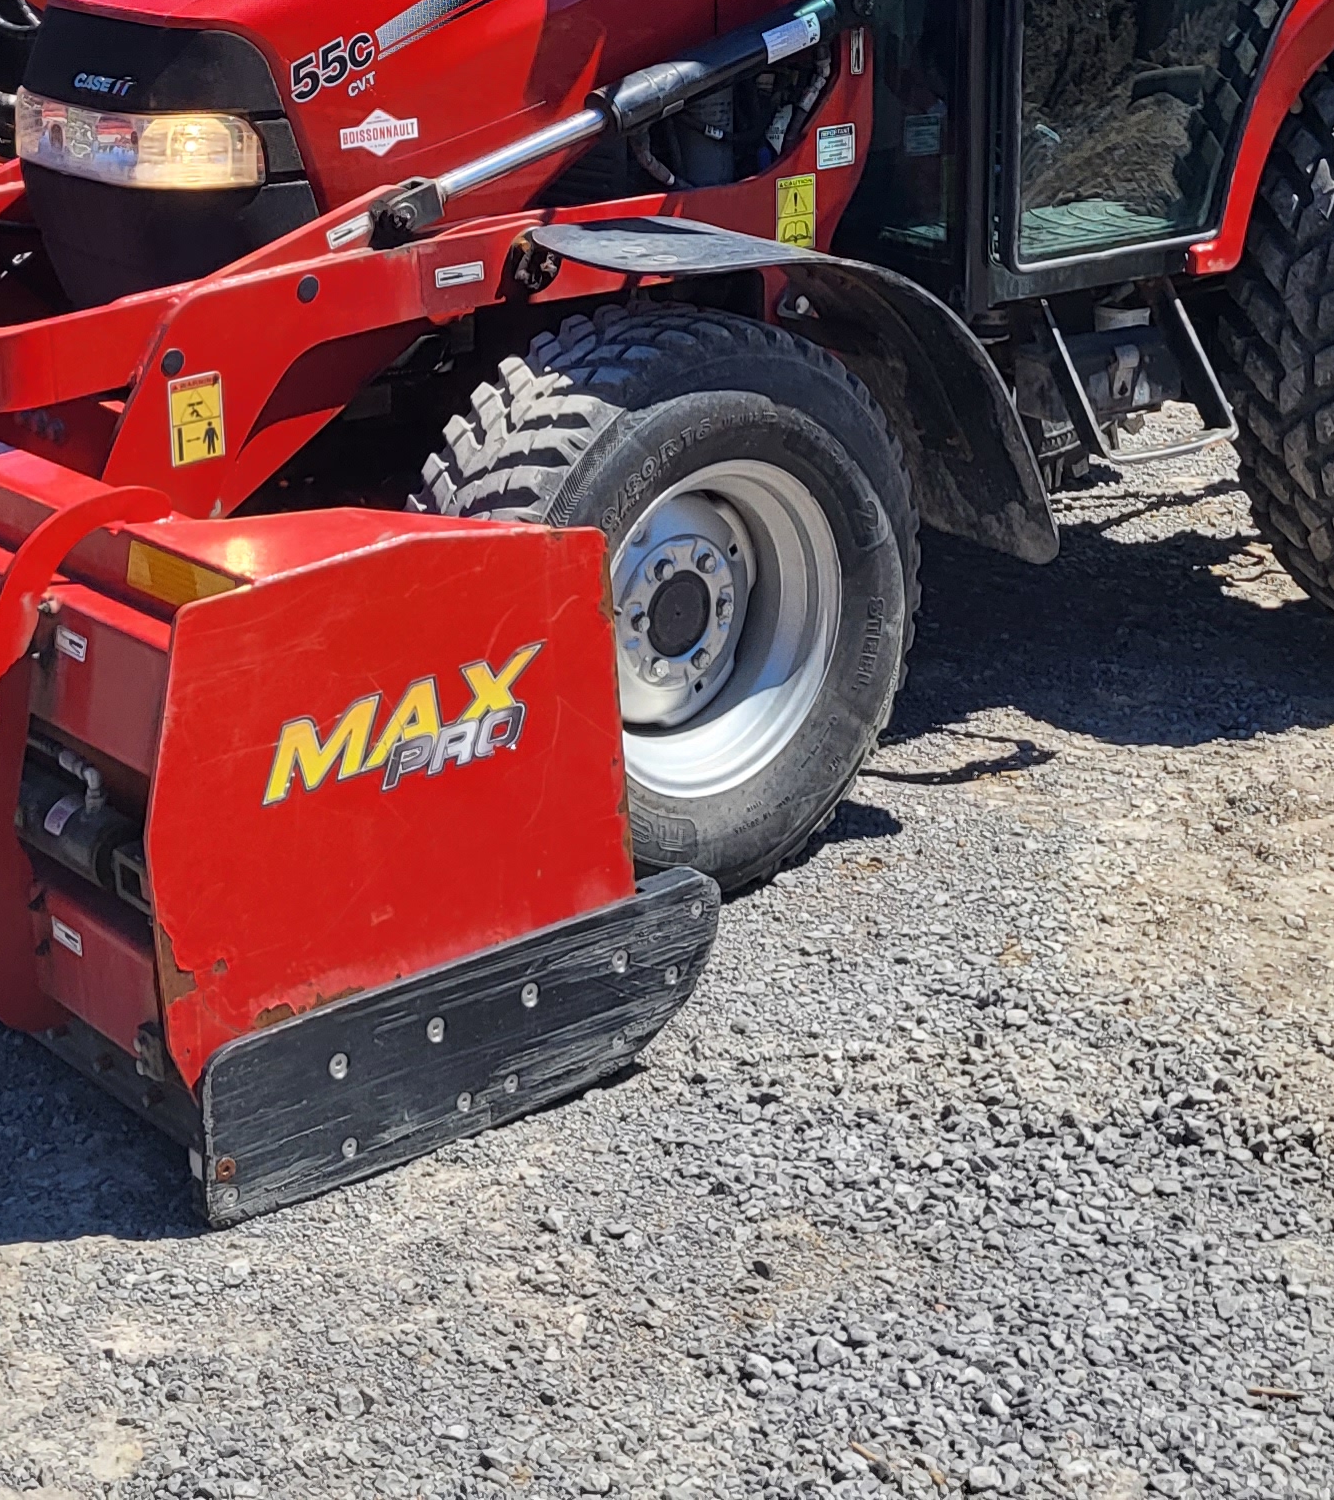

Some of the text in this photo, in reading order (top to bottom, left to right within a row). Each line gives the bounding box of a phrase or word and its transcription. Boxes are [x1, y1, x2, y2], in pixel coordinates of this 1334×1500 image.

[290, 32, 375, 103] 55C
[73, 72, 117, 92] CASE
[348, 71, 376, 97] CVT
[342, 122, 415, 146] BOISSONNAULT
[180, 374, 220, 389] WARNIN
[261, 638, 548, 808] MAX
[381, 701, 527, 793] PRO
